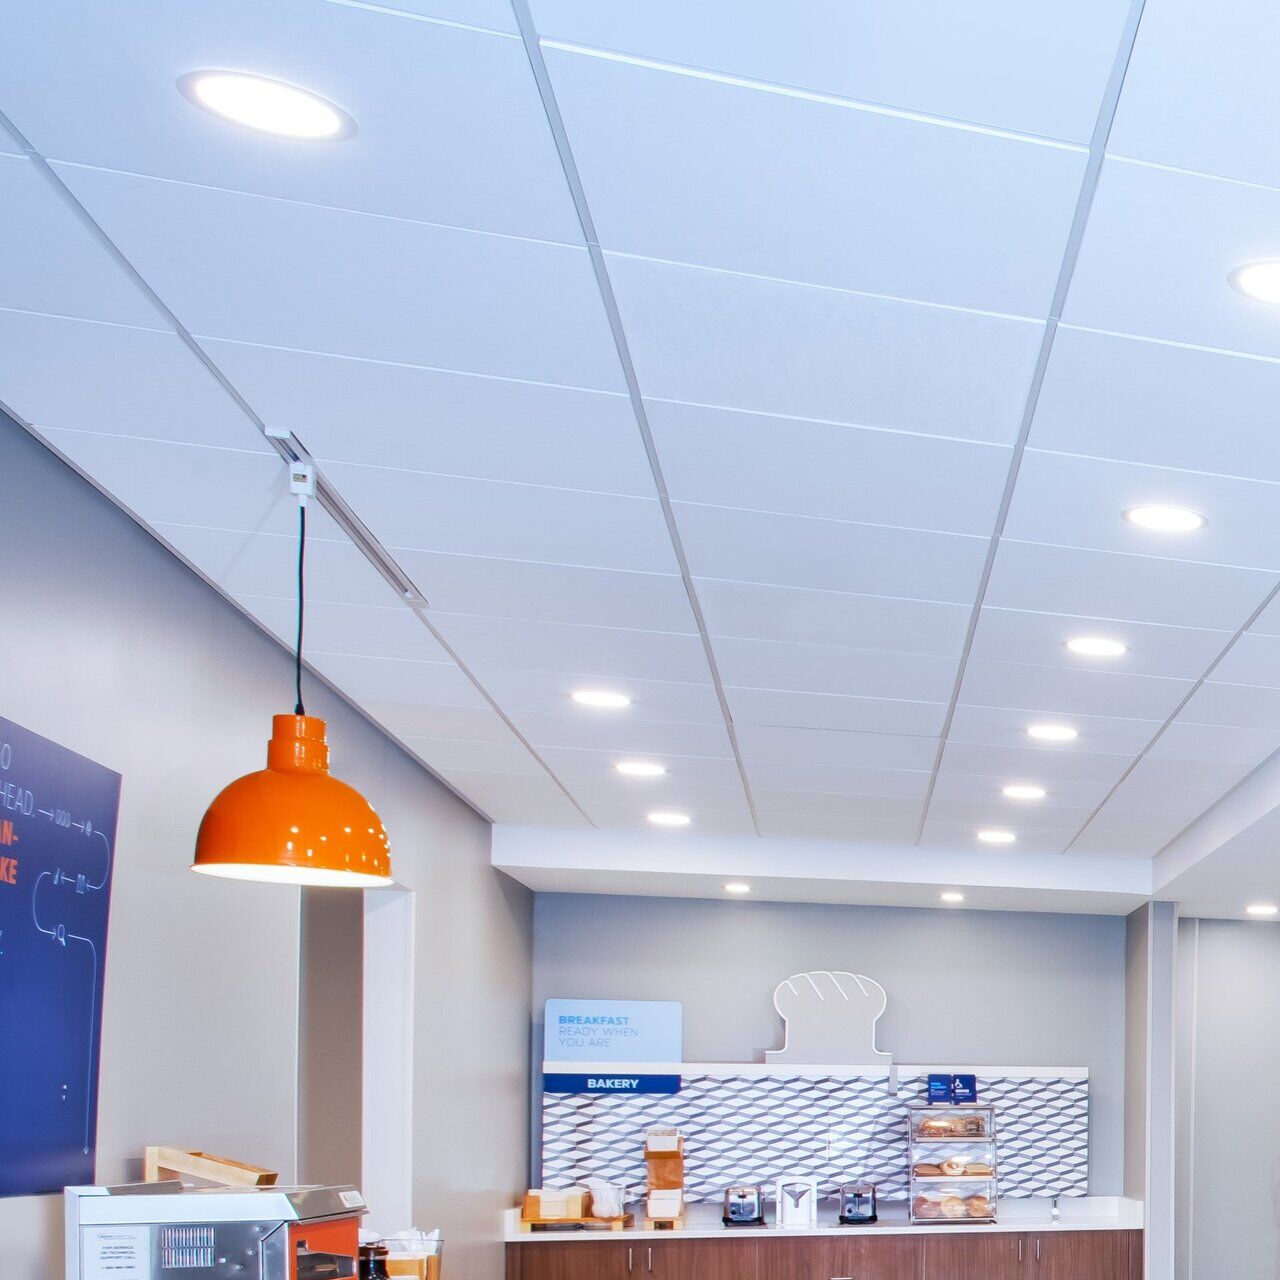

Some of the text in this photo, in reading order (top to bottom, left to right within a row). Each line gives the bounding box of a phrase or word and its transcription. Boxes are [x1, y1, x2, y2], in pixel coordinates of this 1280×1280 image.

[558, 1015, 630, 1026] BREAKFAST
[559, 1026, 639, 1037] READY WHEN
[559, 1037, 611, 1048] YOU ARE
[587, 1078, 640, 1089] BAKERY
